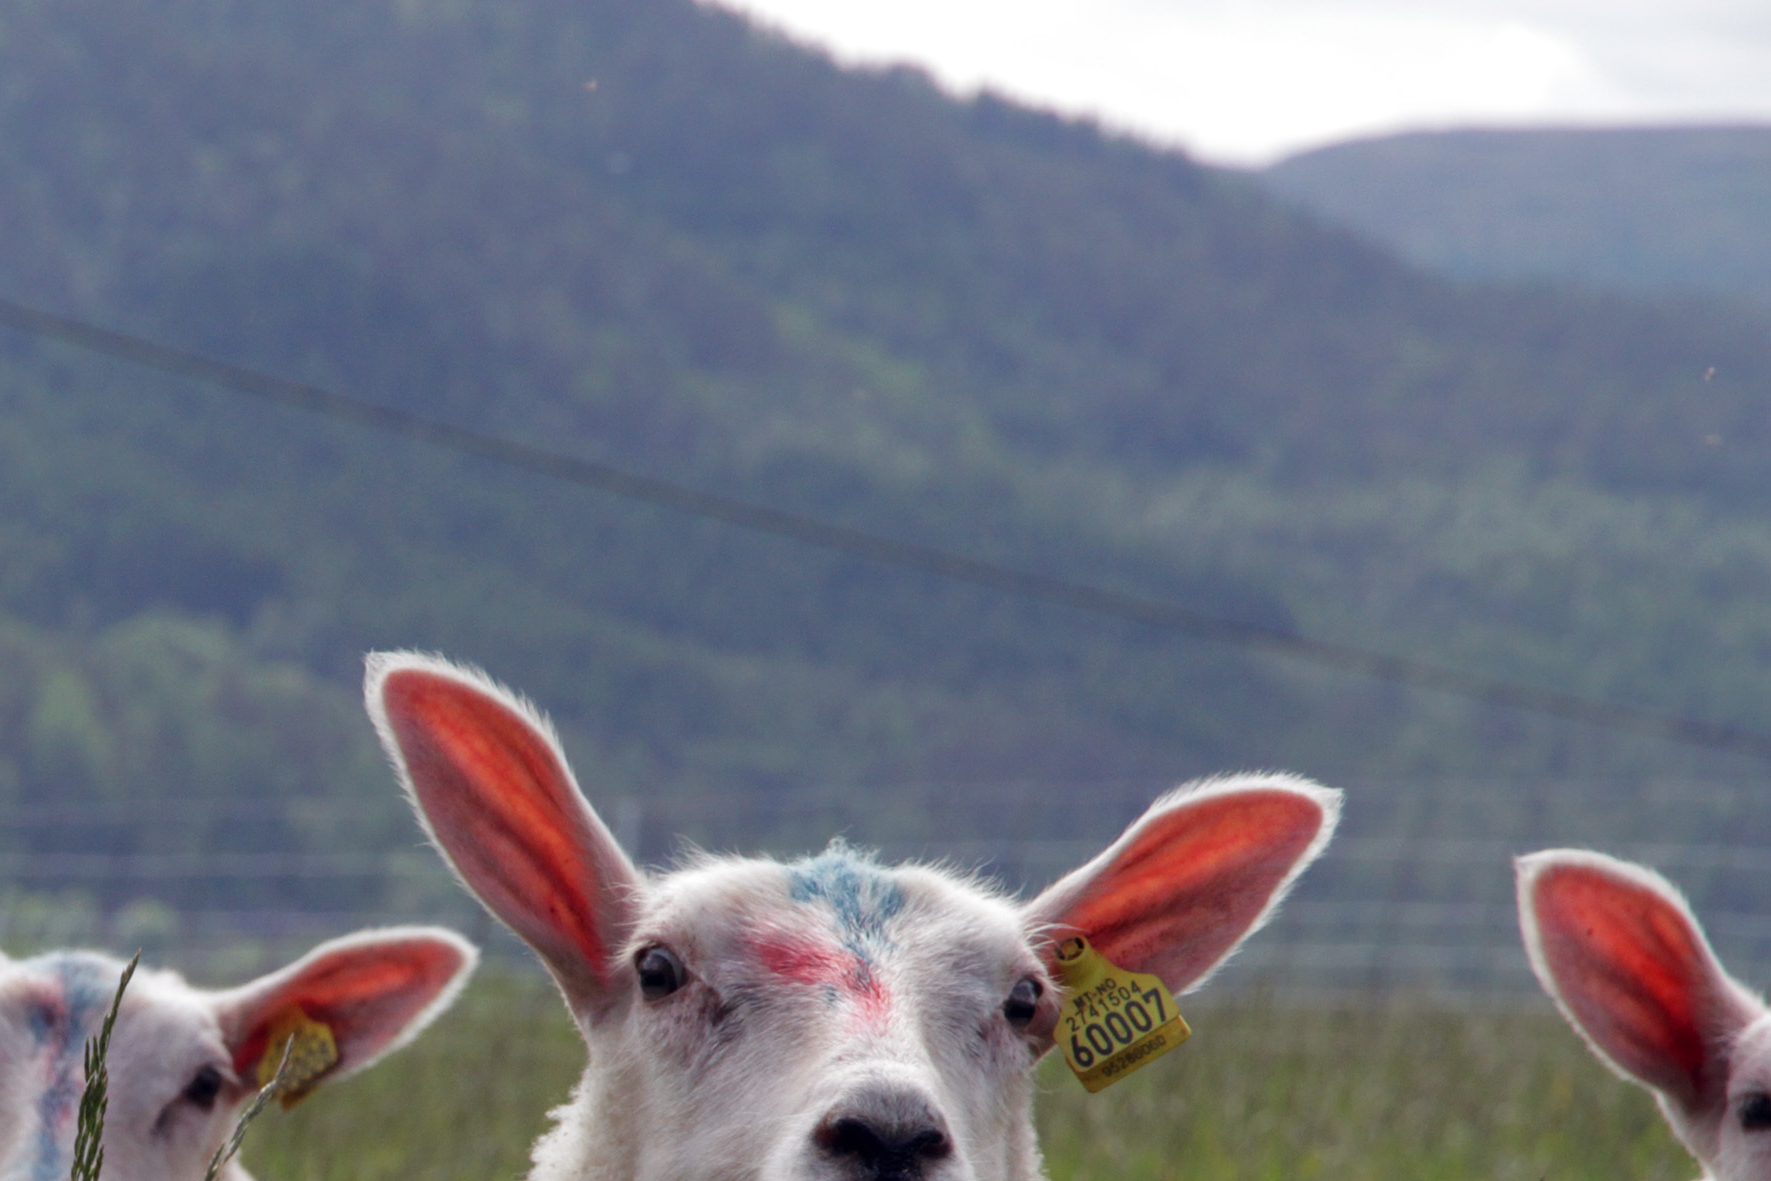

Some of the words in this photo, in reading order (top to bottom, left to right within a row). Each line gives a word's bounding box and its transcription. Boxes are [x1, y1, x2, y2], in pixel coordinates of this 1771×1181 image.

[1066, 981, 1141, 1031] 2741504
[1073, 979, 1116, 1009] MT-NO
[1072, 988, 1166, 1067] 60007
